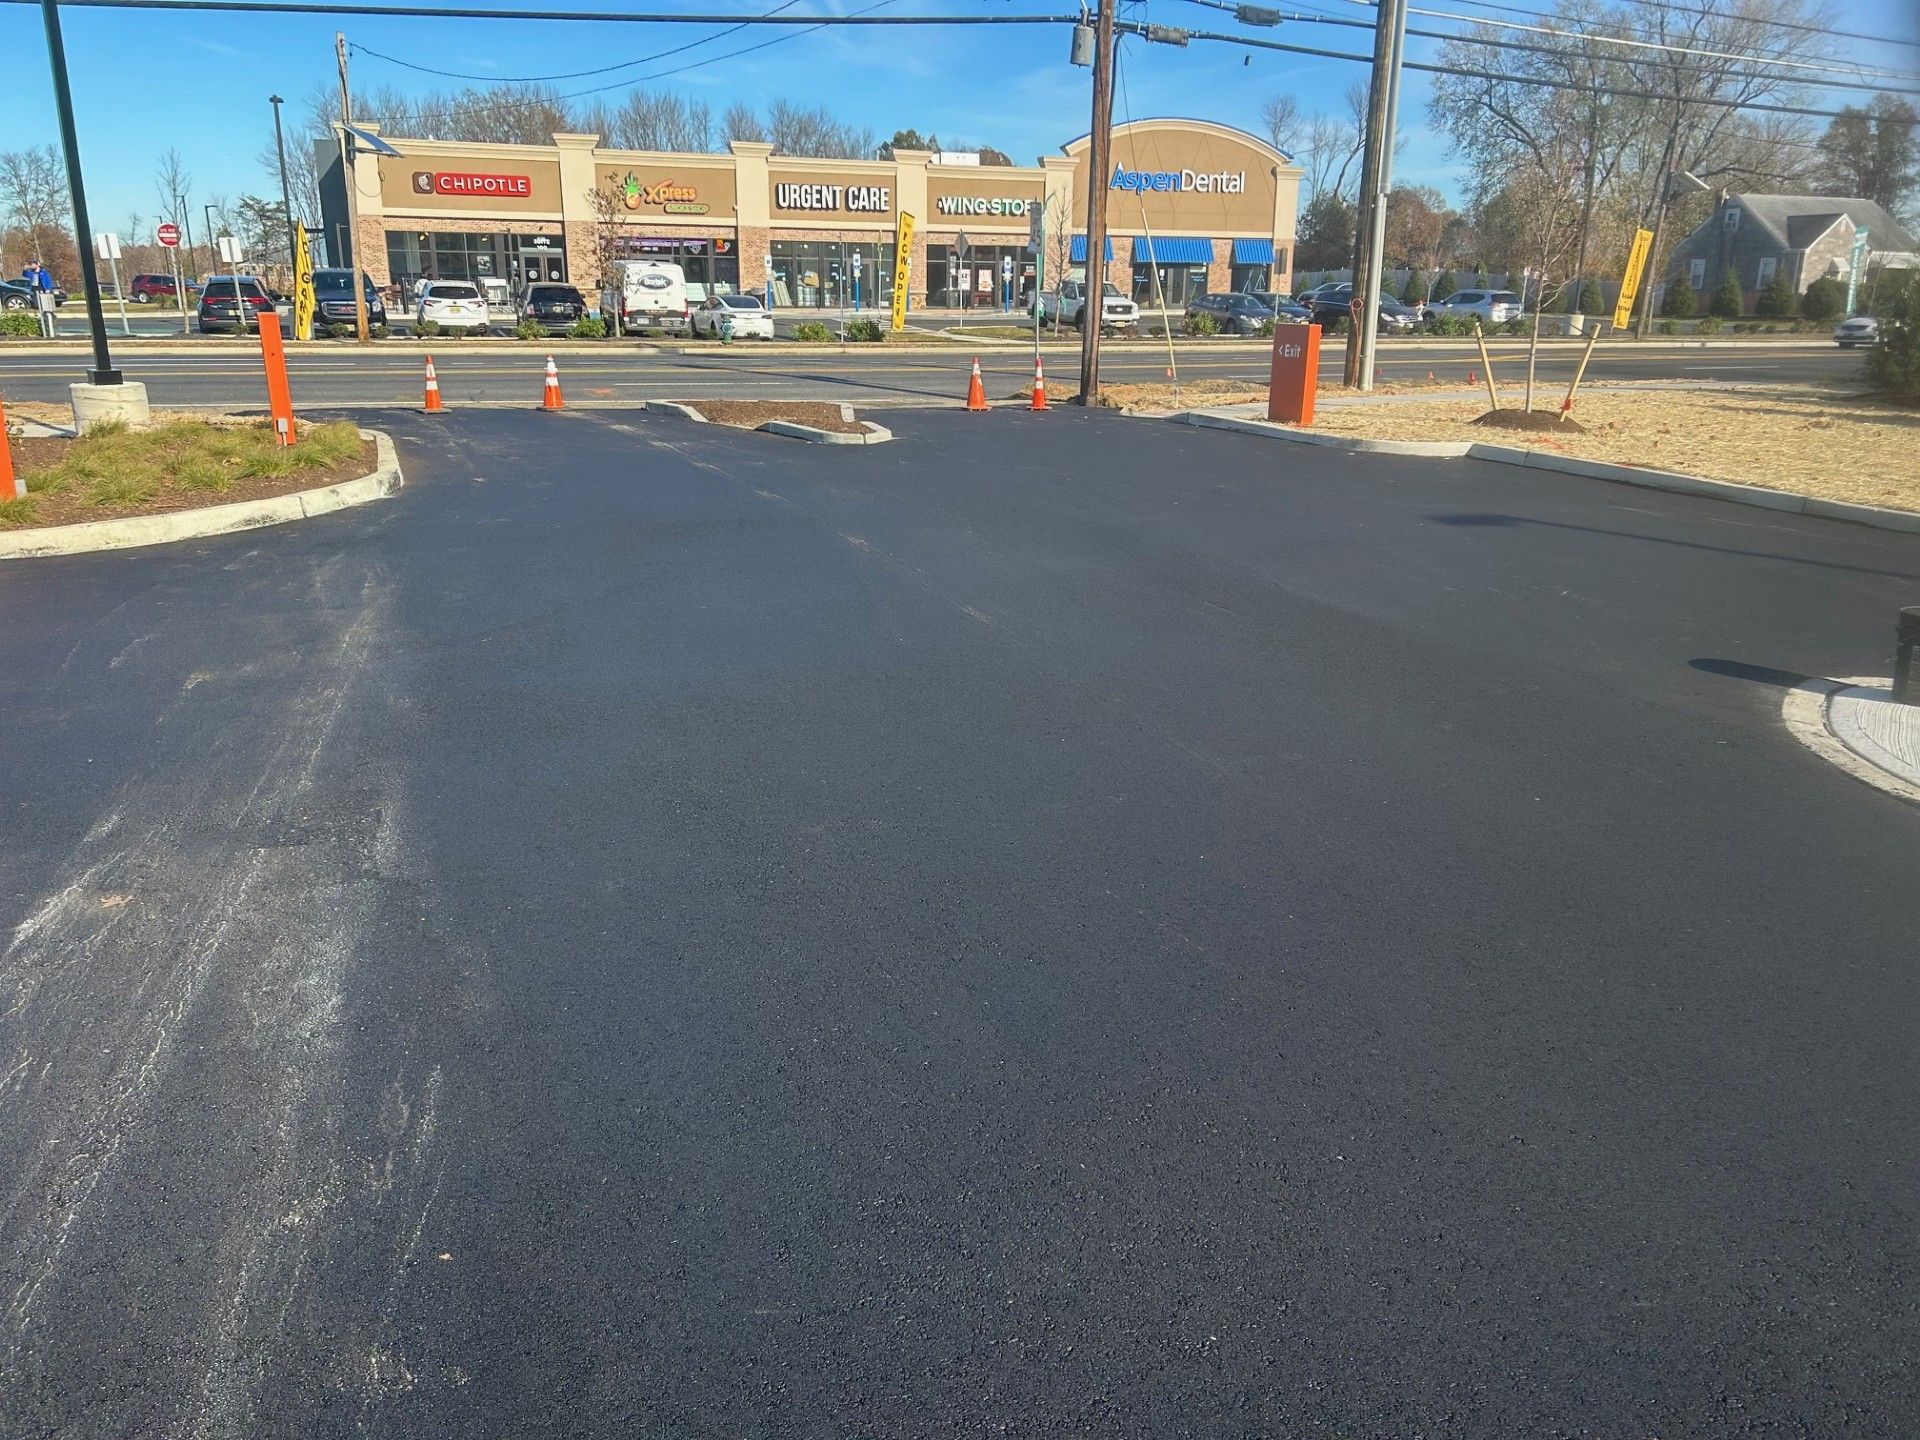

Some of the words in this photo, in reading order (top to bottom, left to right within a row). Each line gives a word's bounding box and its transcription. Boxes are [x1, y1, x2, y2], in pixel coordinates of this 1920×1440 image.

[439, 175, 528, 194] CHIPOTLE
[644, 178, 698, 205] Xpress
[1109, 161, 1246, 195] AspenDental
[776, 183, 844, 209] URGENT
[847, 186, 891, 211] CARE
[1284, 343, 1302, 358] Exit
